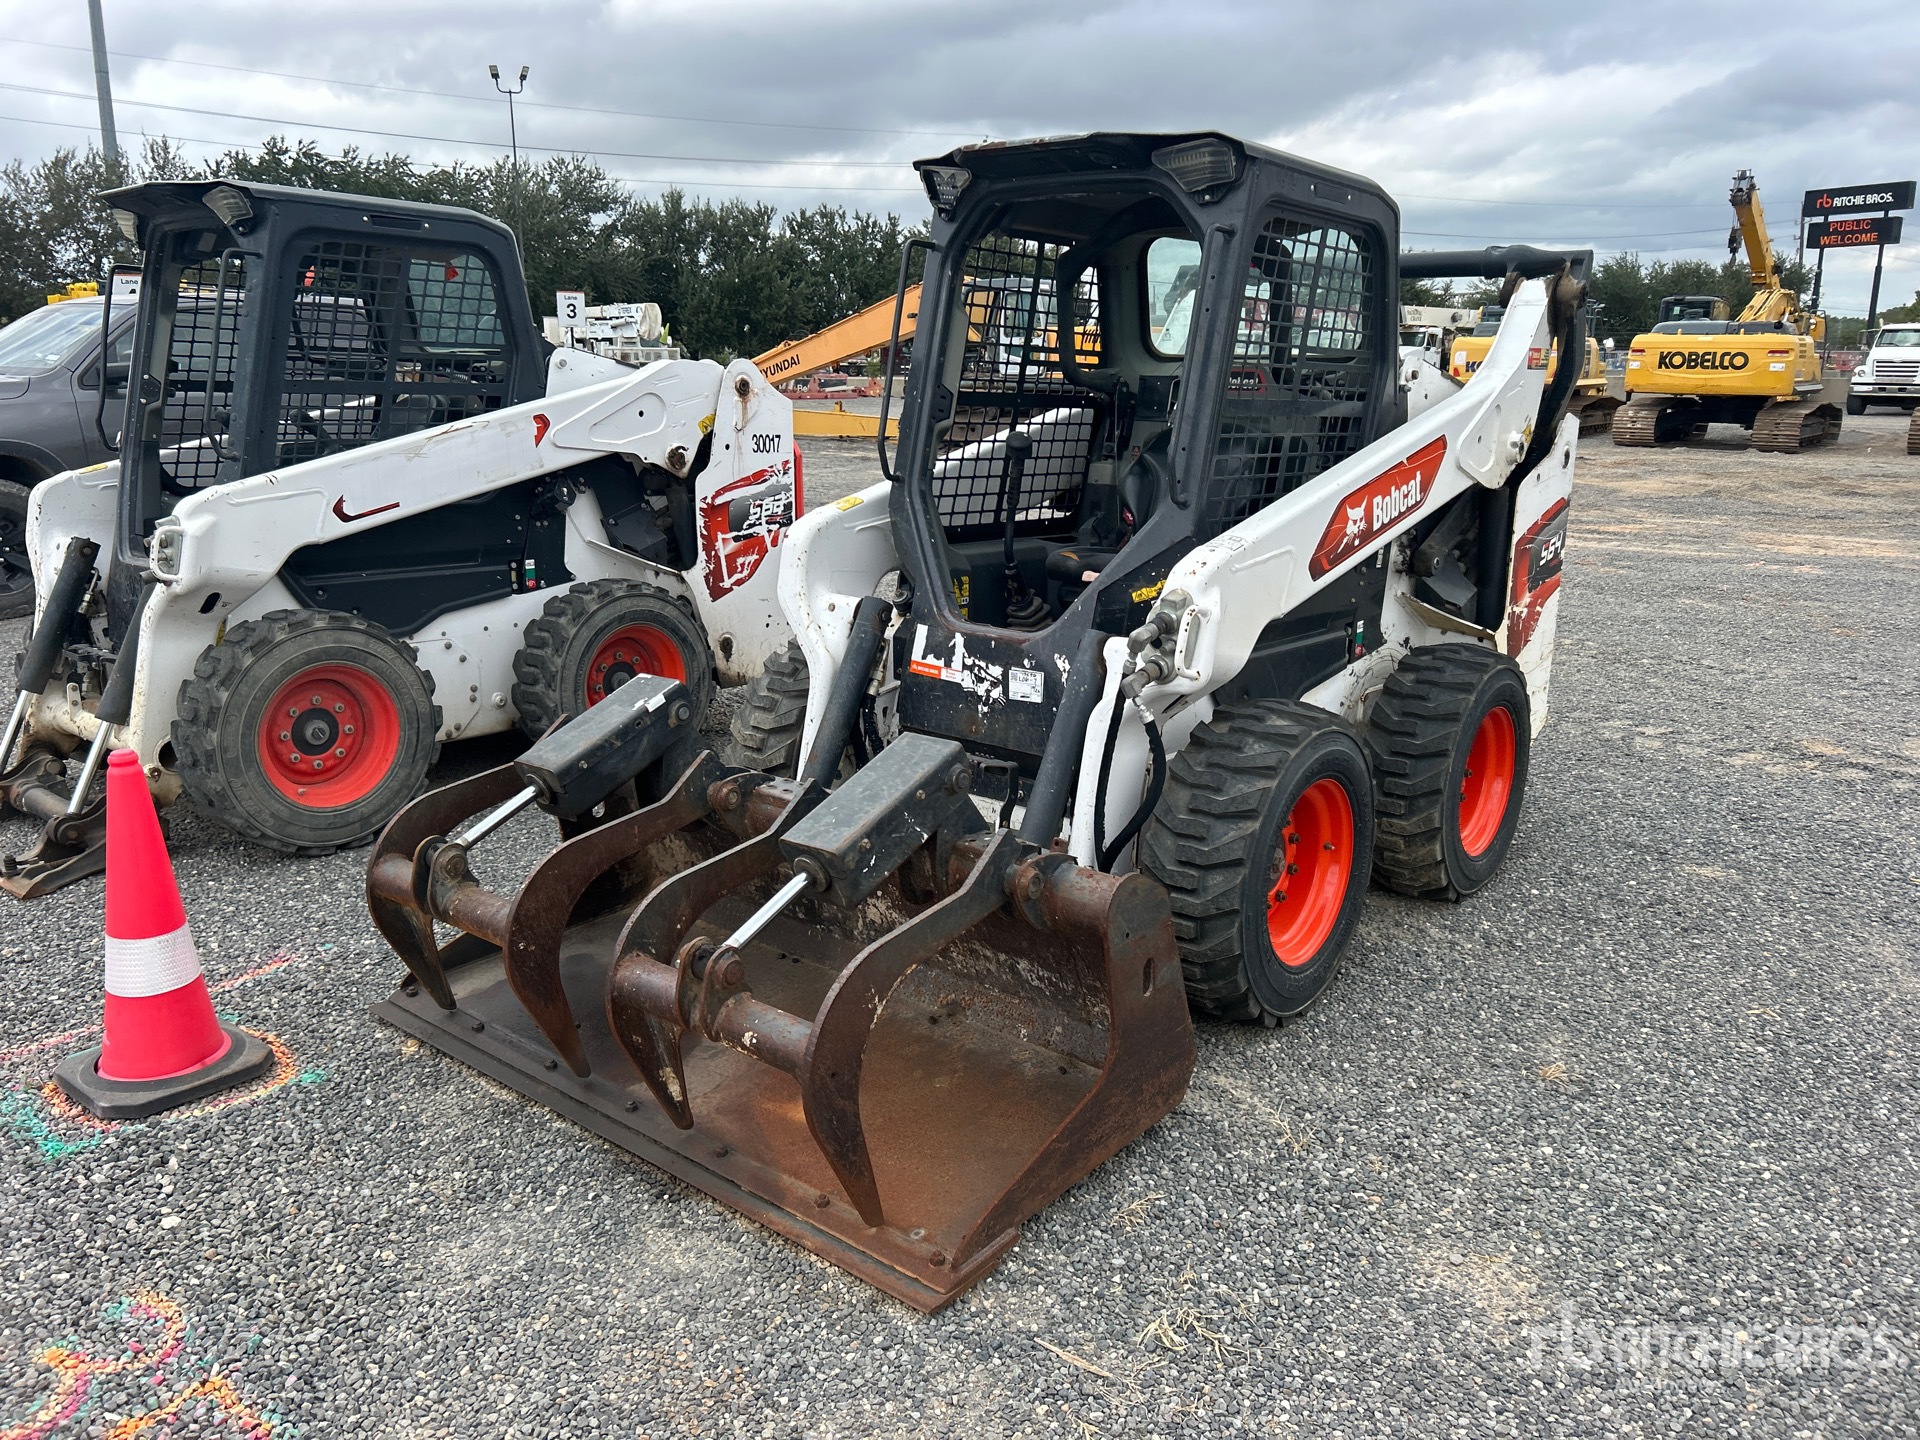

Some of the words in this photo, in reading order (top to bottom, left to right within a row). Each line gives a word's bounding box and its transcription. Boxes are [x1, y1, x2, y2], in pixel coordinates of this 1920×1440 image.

[1833, 194, 1865, 207] RITCHIE
[1866, 192, 1895, 204] BROS.
[1830, 220, 1872, 232] PUBLIC
[1820, 232, 1878, 245] WELCOME
[566, 303, 577, 319] 3
[1657, 351, 1750, 371] KOBELCO
[752, 434, 781, 454] 30017
[1372, 470, 1422, 532] Bobcat
[1539, 530, 1564, 566] S64
